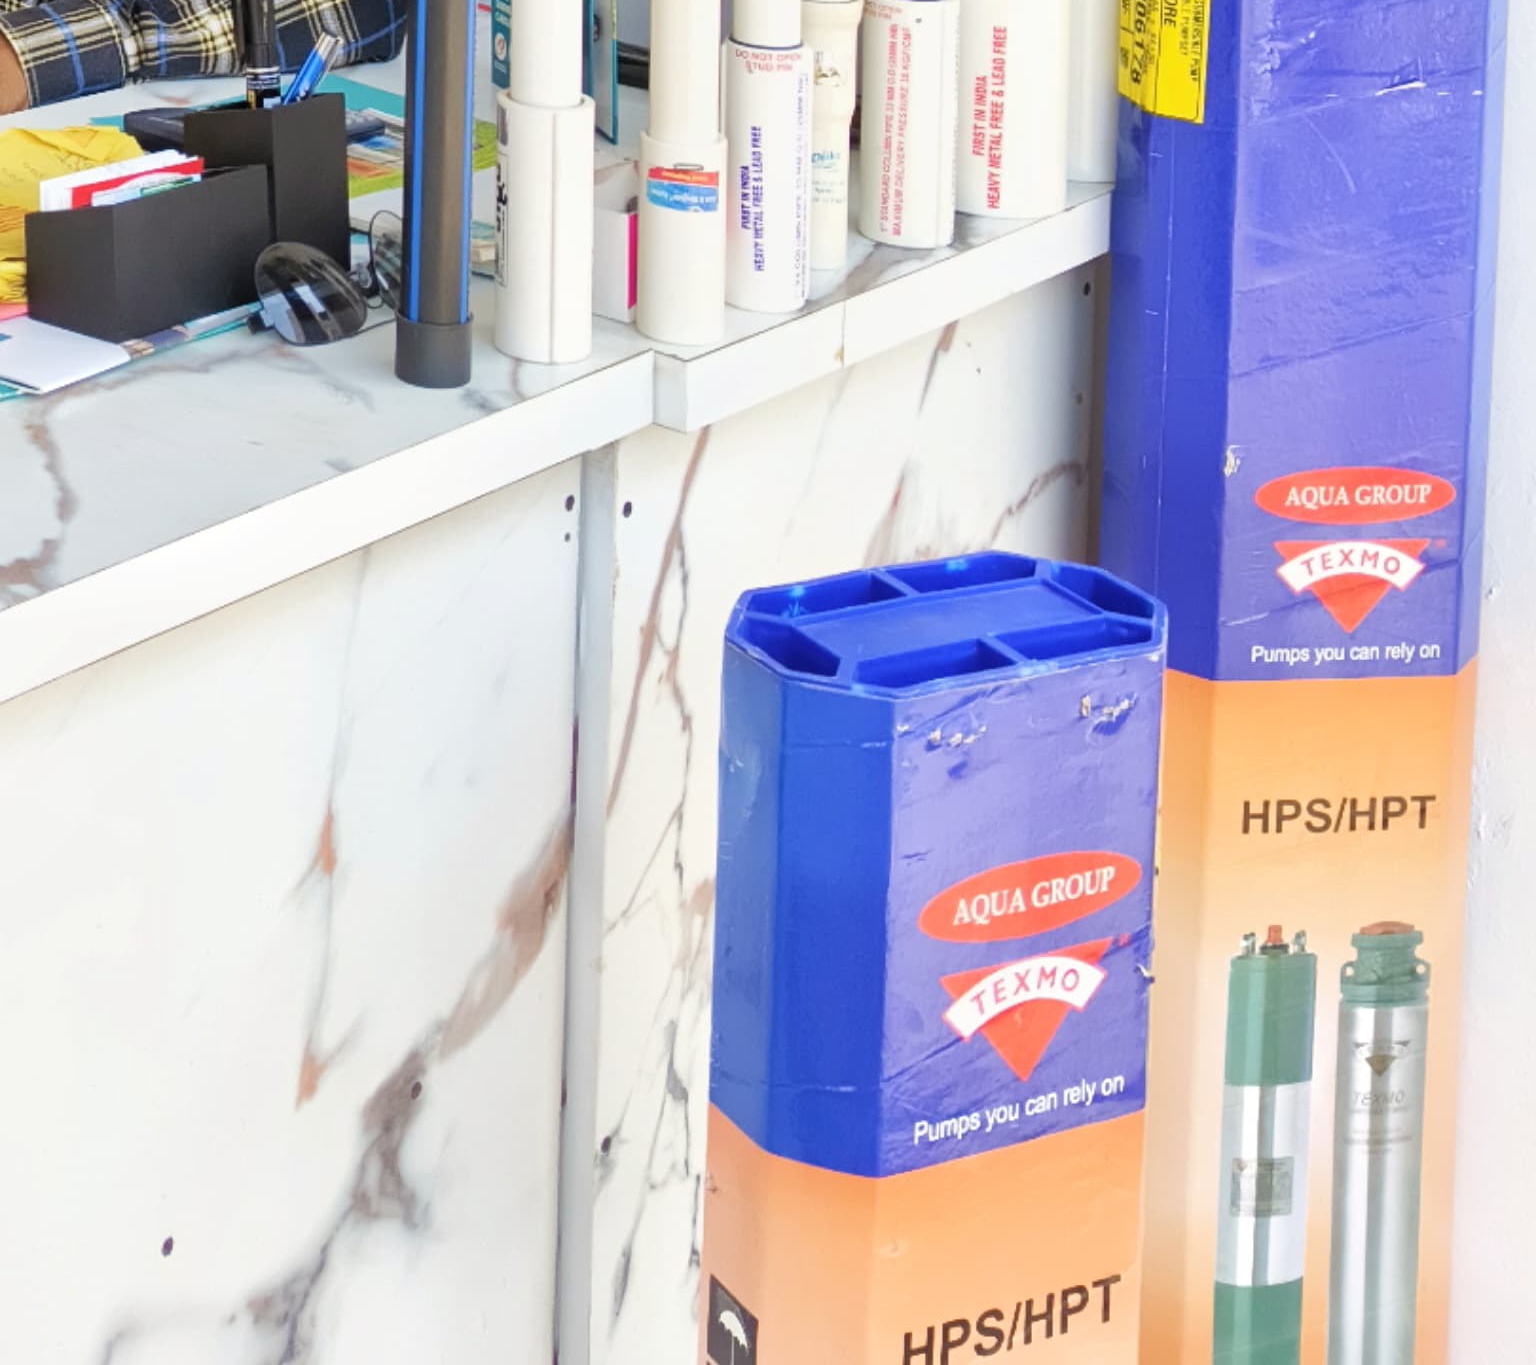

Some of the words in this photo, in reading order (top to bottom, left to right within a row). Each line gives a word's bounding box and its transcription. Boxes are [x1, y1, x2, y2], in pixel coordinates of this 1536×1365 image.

[993, 25, 1007, 55] FREE
[992, 58, 1005, 86] LEAD
[974, 76, 987, 106] INDIA
[896, 86, 909, 137] PRESSURE
[974, 110, 987, 121] IN
[990, 101, 1004, 129] FREE
[751, 126, 761, 148] FREE
[972, 124, 985, 156] FIRST
[988, 132, 1002, 169] METAL
[752, 152, 763, 173] LEAD
[894, 139, 905, 187] DELIVERY
[739, 165, 750, 190] INDIA
[987, 172, 1000, 209] HEAVY
[741, 192, 750, 201] IN
[752, 185, 763, 207] FREE
[880, 174, 890, 221] STANDARD
[741, 204, 751, 229] FIRST
[753, 211, 764, 239] METAL
[753, 242, 764, 271] HEAVY
[1285, 487, 1349, 508] AQUA
[1354, 484, 1431, 505] GROUP
[1300, 549, 1401, 576] TEXMO
[1251, 646, 1310, 665] Pumps
[1314, 647, 1345, 665] you
[1349, 646, 1380, 660] can
[1384, 643, 1415, 662] rely
[1420, 644, 1440, 658] on
[1242, 795, 1437, 835] HPS/HPT
[953, 887, 1027, 927] AQUA
[1031, 866, 1116, 908] GROUP
[970, 963, 1081, 1015] TEXMO
[914, 1108, 981, 1145] Pumps
[985, 1101, 1020, 1133] you
[1024, 1092, 1057, 1117] can
[1063, 1080, 1096, 1107] rely
[1100, 1075, 1124, 1099] on
[902, 1274, 1121, 1365] HPS/HPT
